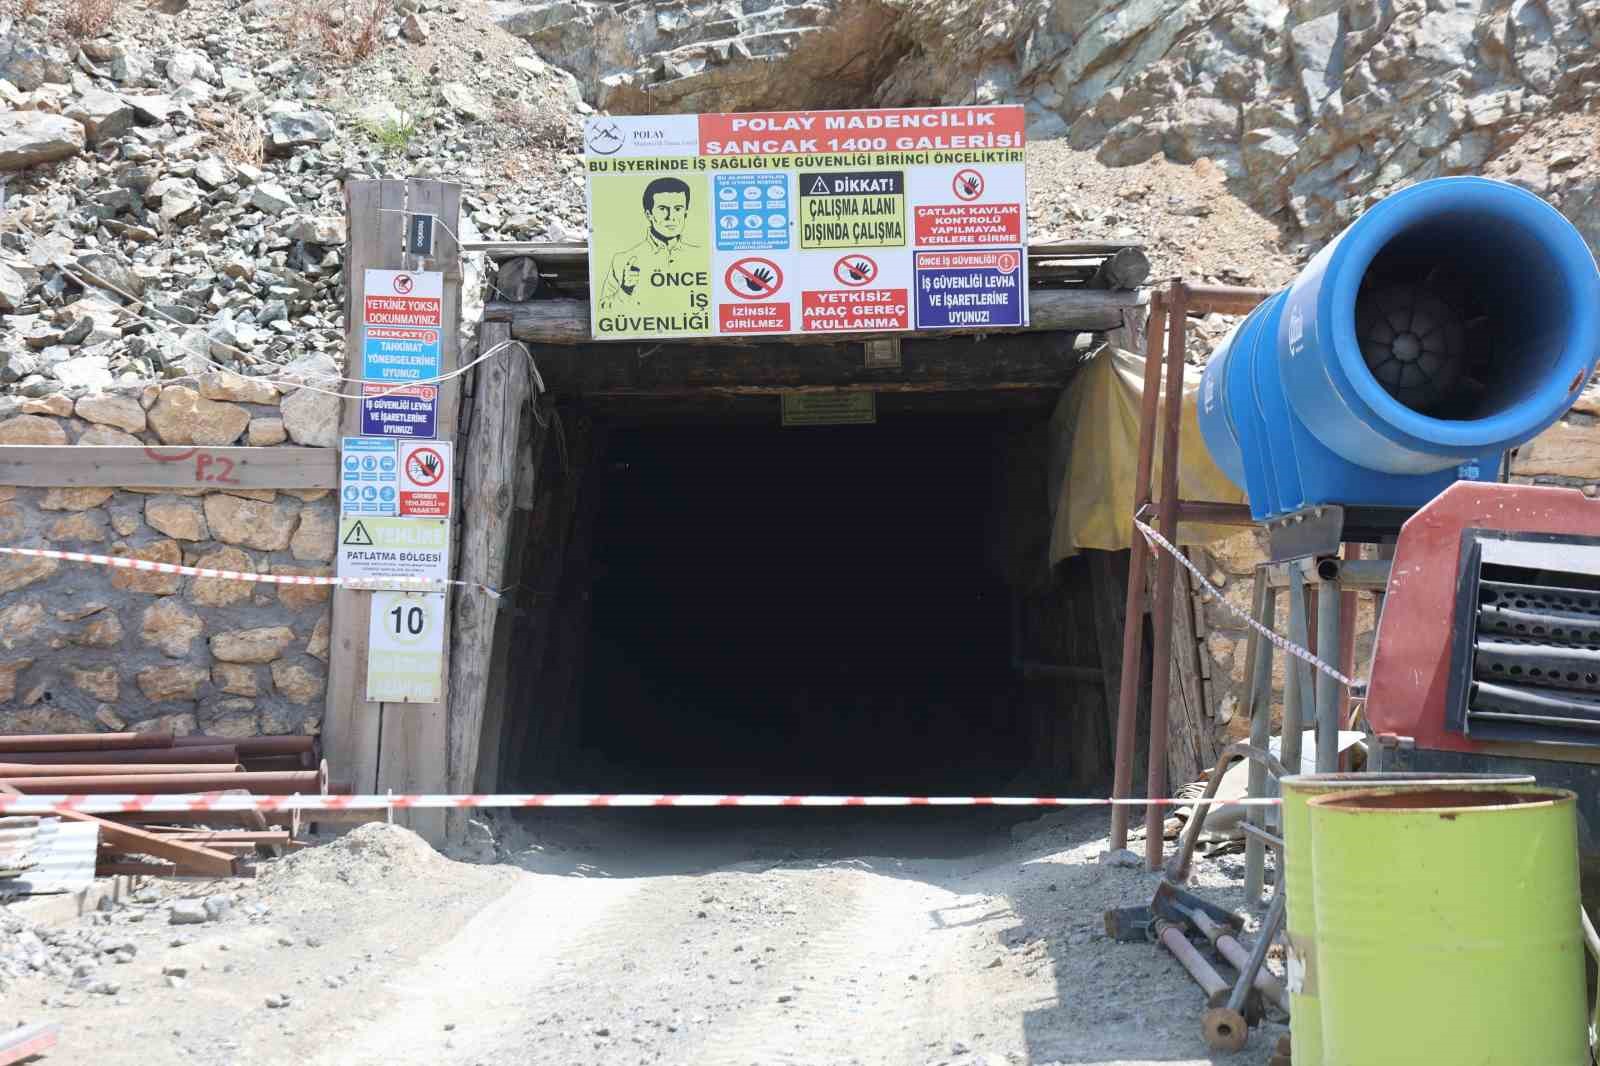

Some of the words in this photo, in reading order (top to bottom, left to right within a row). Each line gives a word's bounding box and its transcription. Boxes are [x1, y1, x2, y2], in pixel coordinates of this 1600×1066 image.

[733, 116, 816, 131] POLAY
[825, 109, 996, 129] MADENCİLİK
[633, 130, 664, 139] POLAY
[706, 138, 817, 154] SANCAK
[828, 137, 887, 151] 1400
[896, 131, 1021, 149] GALERİSİ
[589, 160, 608, 172] BU
[613, 158, 689, 173] İŞYERİNDE
[693, 157, 706, 171] İŞ
[711, 155, 767, 170] SAĞLIĞI
[773, 157, 790, 168] VE
[795, 152, 871, 168] GÜVENLİĞİ
[876, 152, 929, 165] BİRİNCİ
[934, 149, 1023, 165] ÖNCELİKTİR!
[834, 177, 894, 193] DİKKAT!
[810, 198, 858, 221] ÇALIŞMA
[862, 197, 896, 216] ALANI
[918, 207, 965, 218] ÇATLAK
[969, 206, 1019, 216] KAVLAK
[935, 215, 1001, 225] KONTROLÜ
[804, 223, 849, 246] DIŞINDA
[853, 221, 901, 245] ÇALIŞMA
[931, 225, 1007, 235] YAPILMAYAN
[920, 235, 976, 244] YERLERE
[978, 233, 1017, 243] GİRME
[919, 256, 941, 266] ÖNCE
[650, 269, 708, 287] ÖNCE
[922, 275, 931, 292] İŞ
[933, 273, 983, 289] GÜVENLİĞİ
[985, 275, 1015, 288] LEVHA
[690, 290, 709, 311] İŞ
[818, 290, 892, 303] YETKİSİZ
[929, 294, 942, 306] VE
[943, 290, 1009, 309] İŞARETLERİNE
[367, 298, 407, 310] YETKİNİZ
[408, 301, 439, 311] YOKSA
[369, 312, 437, 324] DOKUNMAYINIZ
[732, 306, 777, 317] İZİNSİZ
[804, 306, 847, 319] ARAÇ
[852, 304, 906, 317] GEREÇ
[949, 310, 990, 323] UYUNUZ!
[598, 311, 709, 332] GÜVENLİĞİ
[726, 318, 784, 330] GİRİLMEZ
[810, 317, 900, 329] KULLANMA
[366, 399, 373, 411] İŞ
[411, 401, 432, 411] LEVHA
[370, 412, 380, 421] VE
[346, 551, 397, 561] PATLATMA
[399, 551, 442, 563] BÖLGESİ
[391, 606, 424, 635] 10
